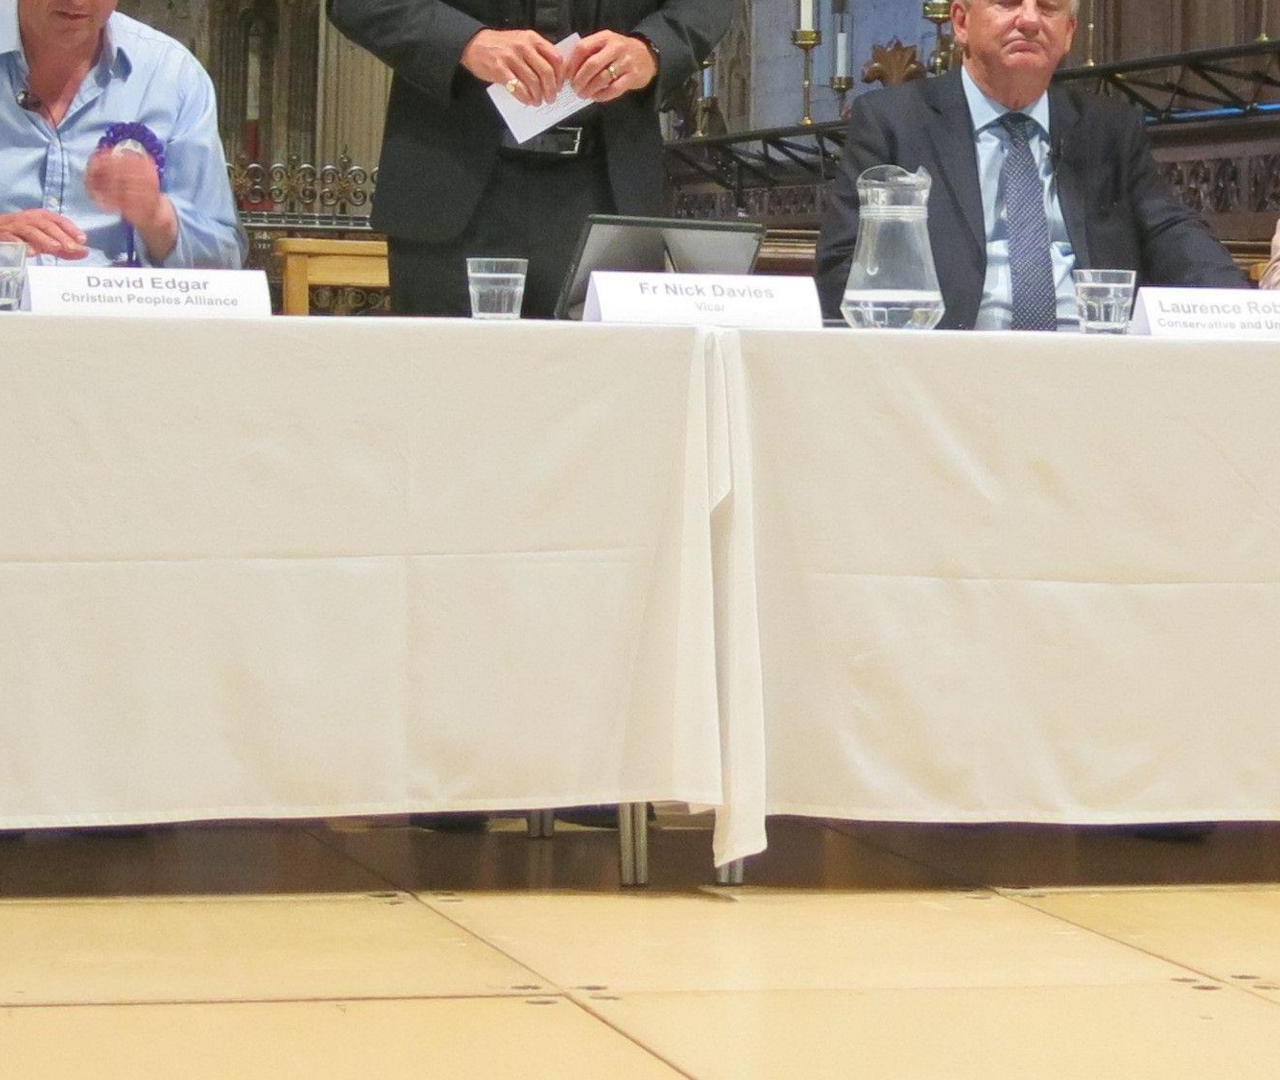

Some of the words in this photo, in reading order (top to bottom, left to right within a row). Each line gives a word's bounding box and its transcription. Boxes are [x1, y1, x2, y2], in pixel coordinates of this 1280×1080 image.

[87, 276, 144, 289] David
[151, 277, 209, 292] Edgar
[639, 282, 658, 295] Fr
[664, 283, 705, 297] Nick
[712, 284, 775, 299] Davies
[61, 292, 122, 304] Christian
[127, 294, 181, 307] Peoples
[185, 296, 239, 307] Alliance
[1158, 300, 1241, 315] Laurence
[1157, 318, 1237, 329] Conservative
[1240, 320, 1262, 330] and
